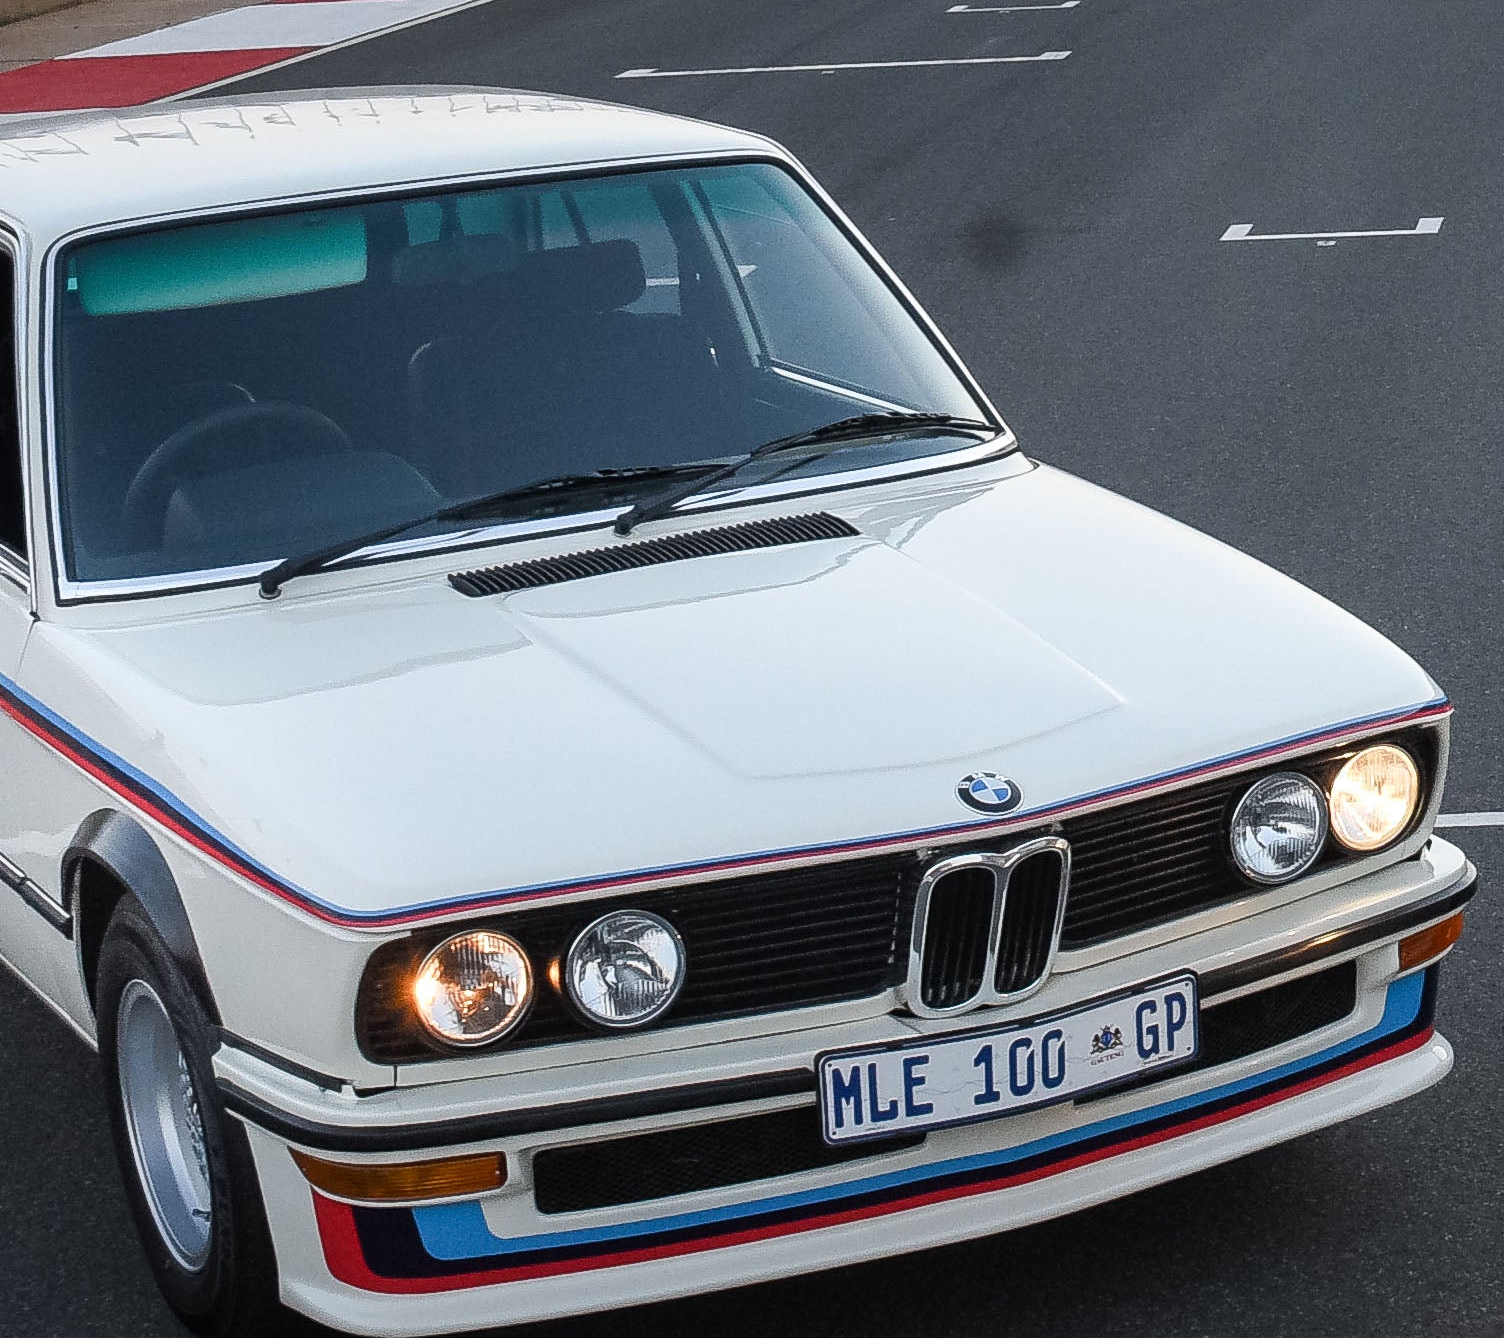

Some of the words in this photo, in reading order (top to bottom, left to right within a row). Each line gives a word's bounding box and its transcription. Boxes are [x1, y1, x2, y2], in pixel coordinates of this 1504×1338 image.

[831, 1054, 934, 1129] MLE
[973, 1028, 1067, 1106] 100
[1135, 991, 1188, 1061] GP
